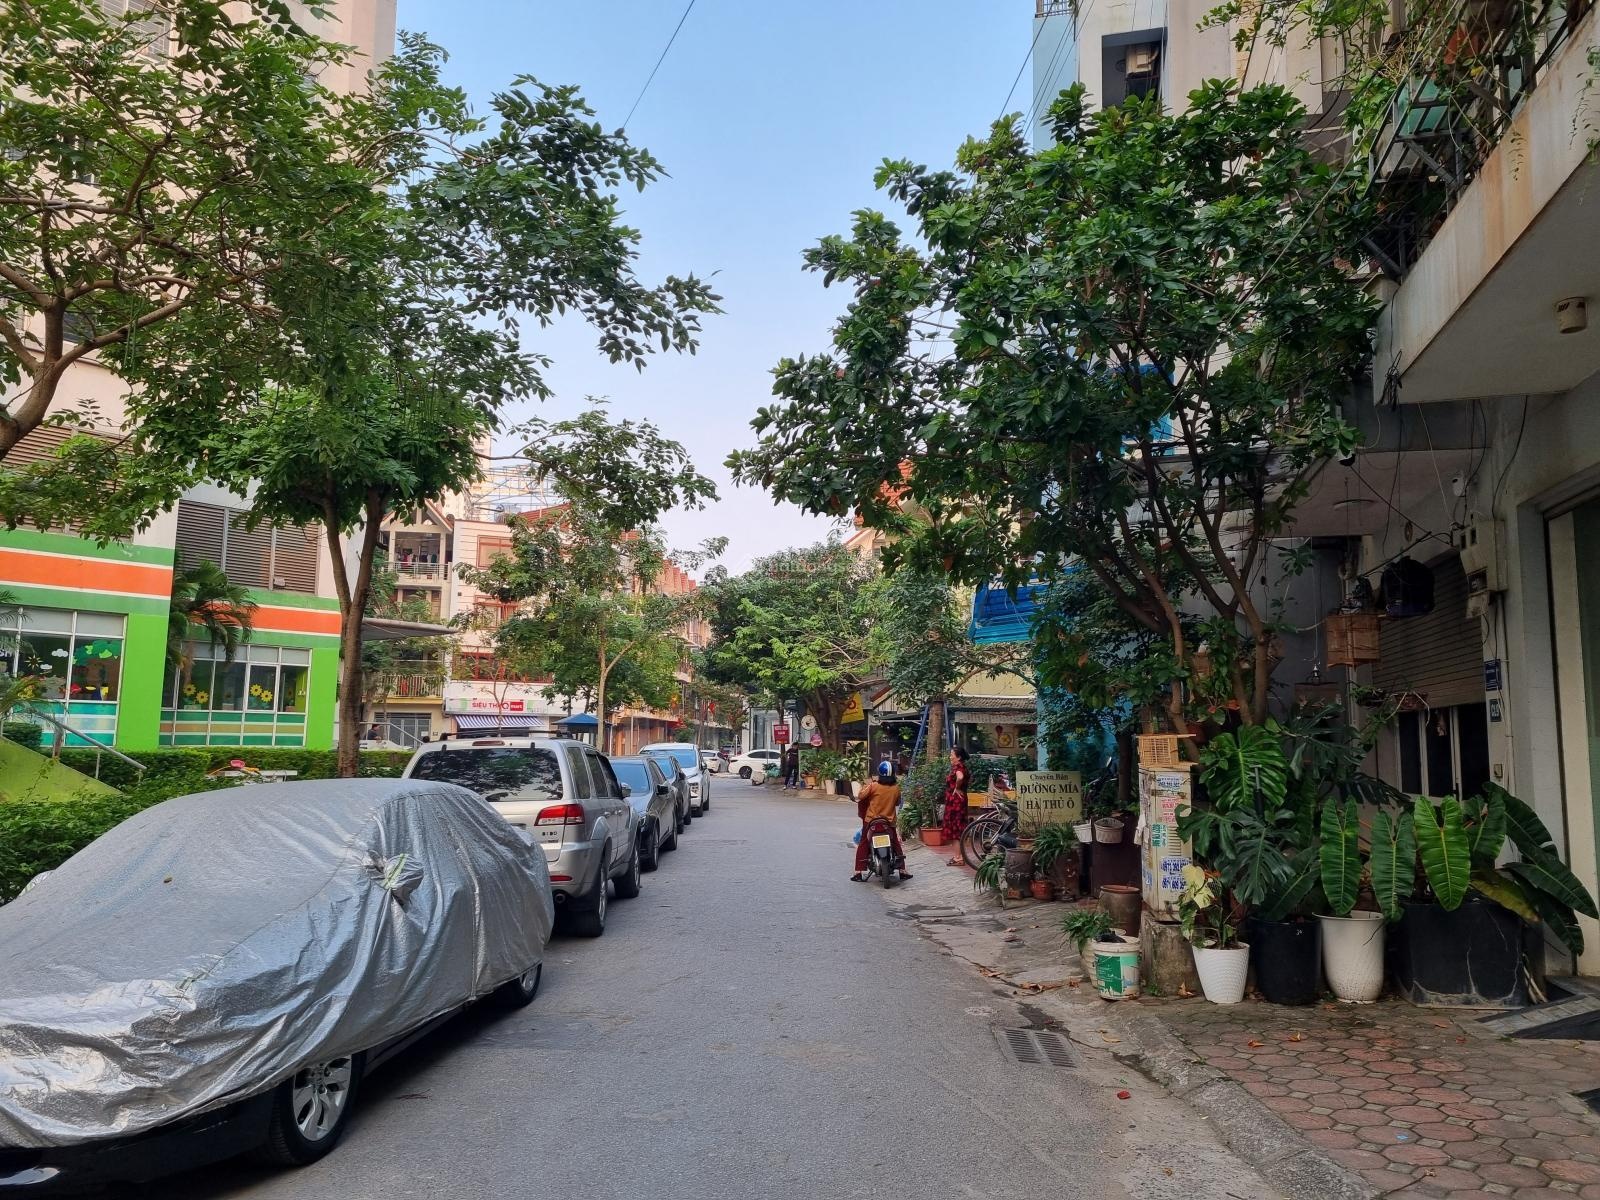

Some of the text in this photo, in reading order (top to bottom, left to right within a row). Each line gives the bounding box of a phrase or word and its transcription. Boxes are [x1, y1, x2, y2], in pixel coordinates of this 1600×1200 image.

[1020, 781, 1079, 793] ĐƯỜNG MÍA
[1026, 796, 1075, 809] HÀ THỦ Ô
